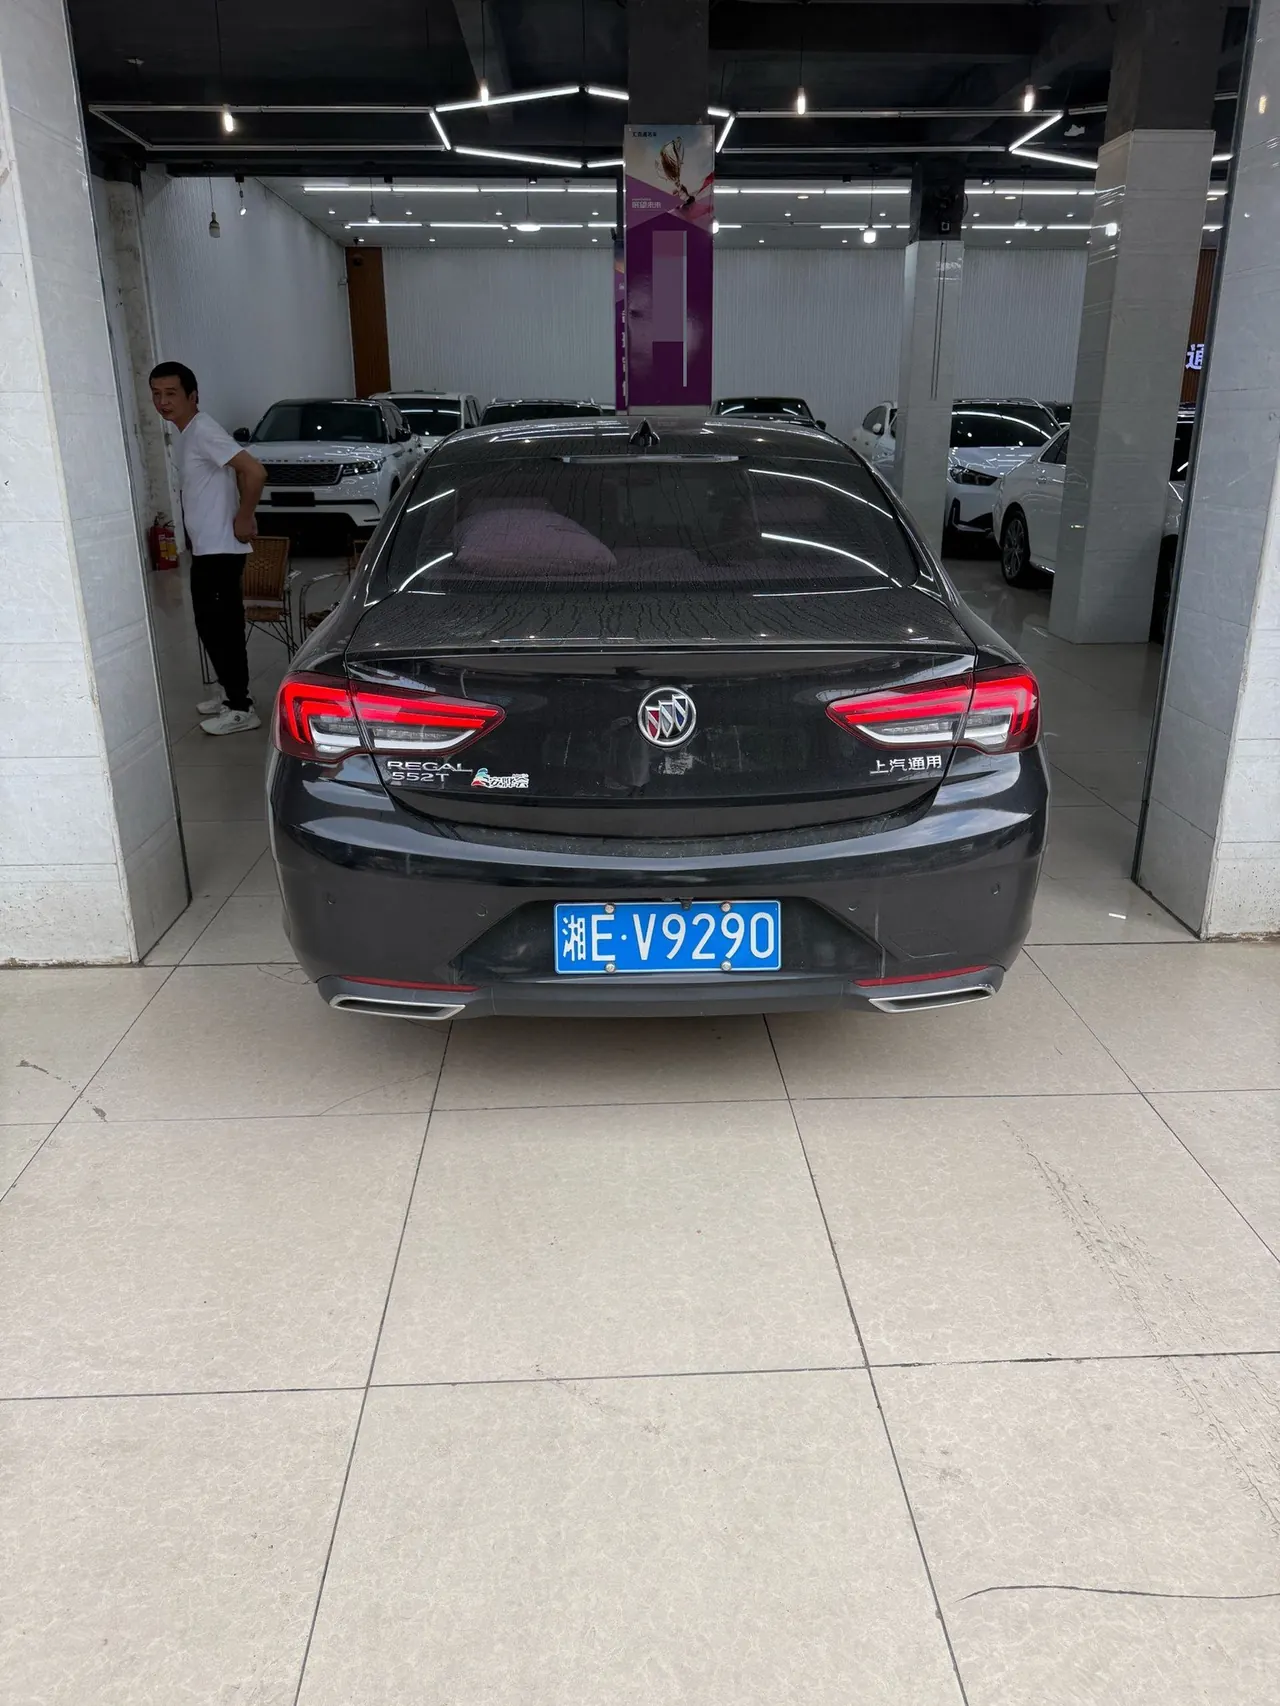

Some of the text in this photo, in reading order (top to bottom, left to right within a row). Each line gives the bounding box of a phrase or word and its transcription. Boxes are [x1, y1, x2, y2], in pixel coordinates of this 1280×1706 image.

[386, 761, 474, 773] REGAL
[869, 755, 942, 775] 上汽通用
[391, 771, 450, 782] 552T
[562, 912, 774, 961] 湘E·V9290
